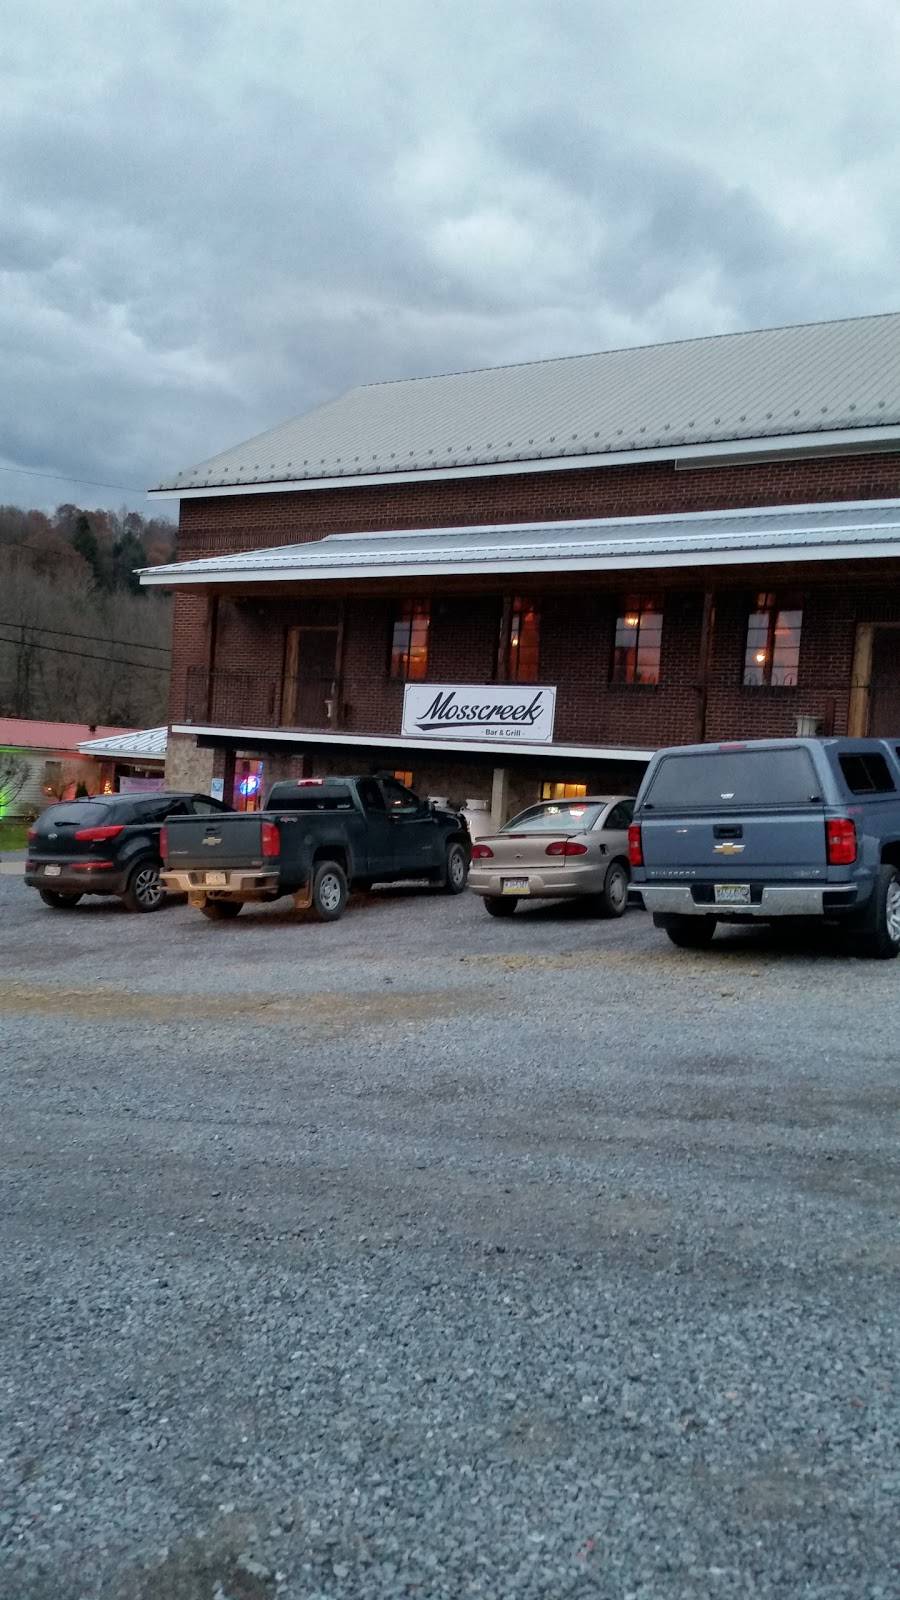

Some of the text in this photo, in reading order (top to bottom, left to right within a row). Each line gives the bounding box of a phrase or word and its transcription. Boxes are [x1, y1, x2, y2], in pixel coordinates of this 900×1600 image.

[416, 691, 544, 721] Mosscreek
[485, 728, 498, 736] Bar
[505, 729, 521, 737] Grill
